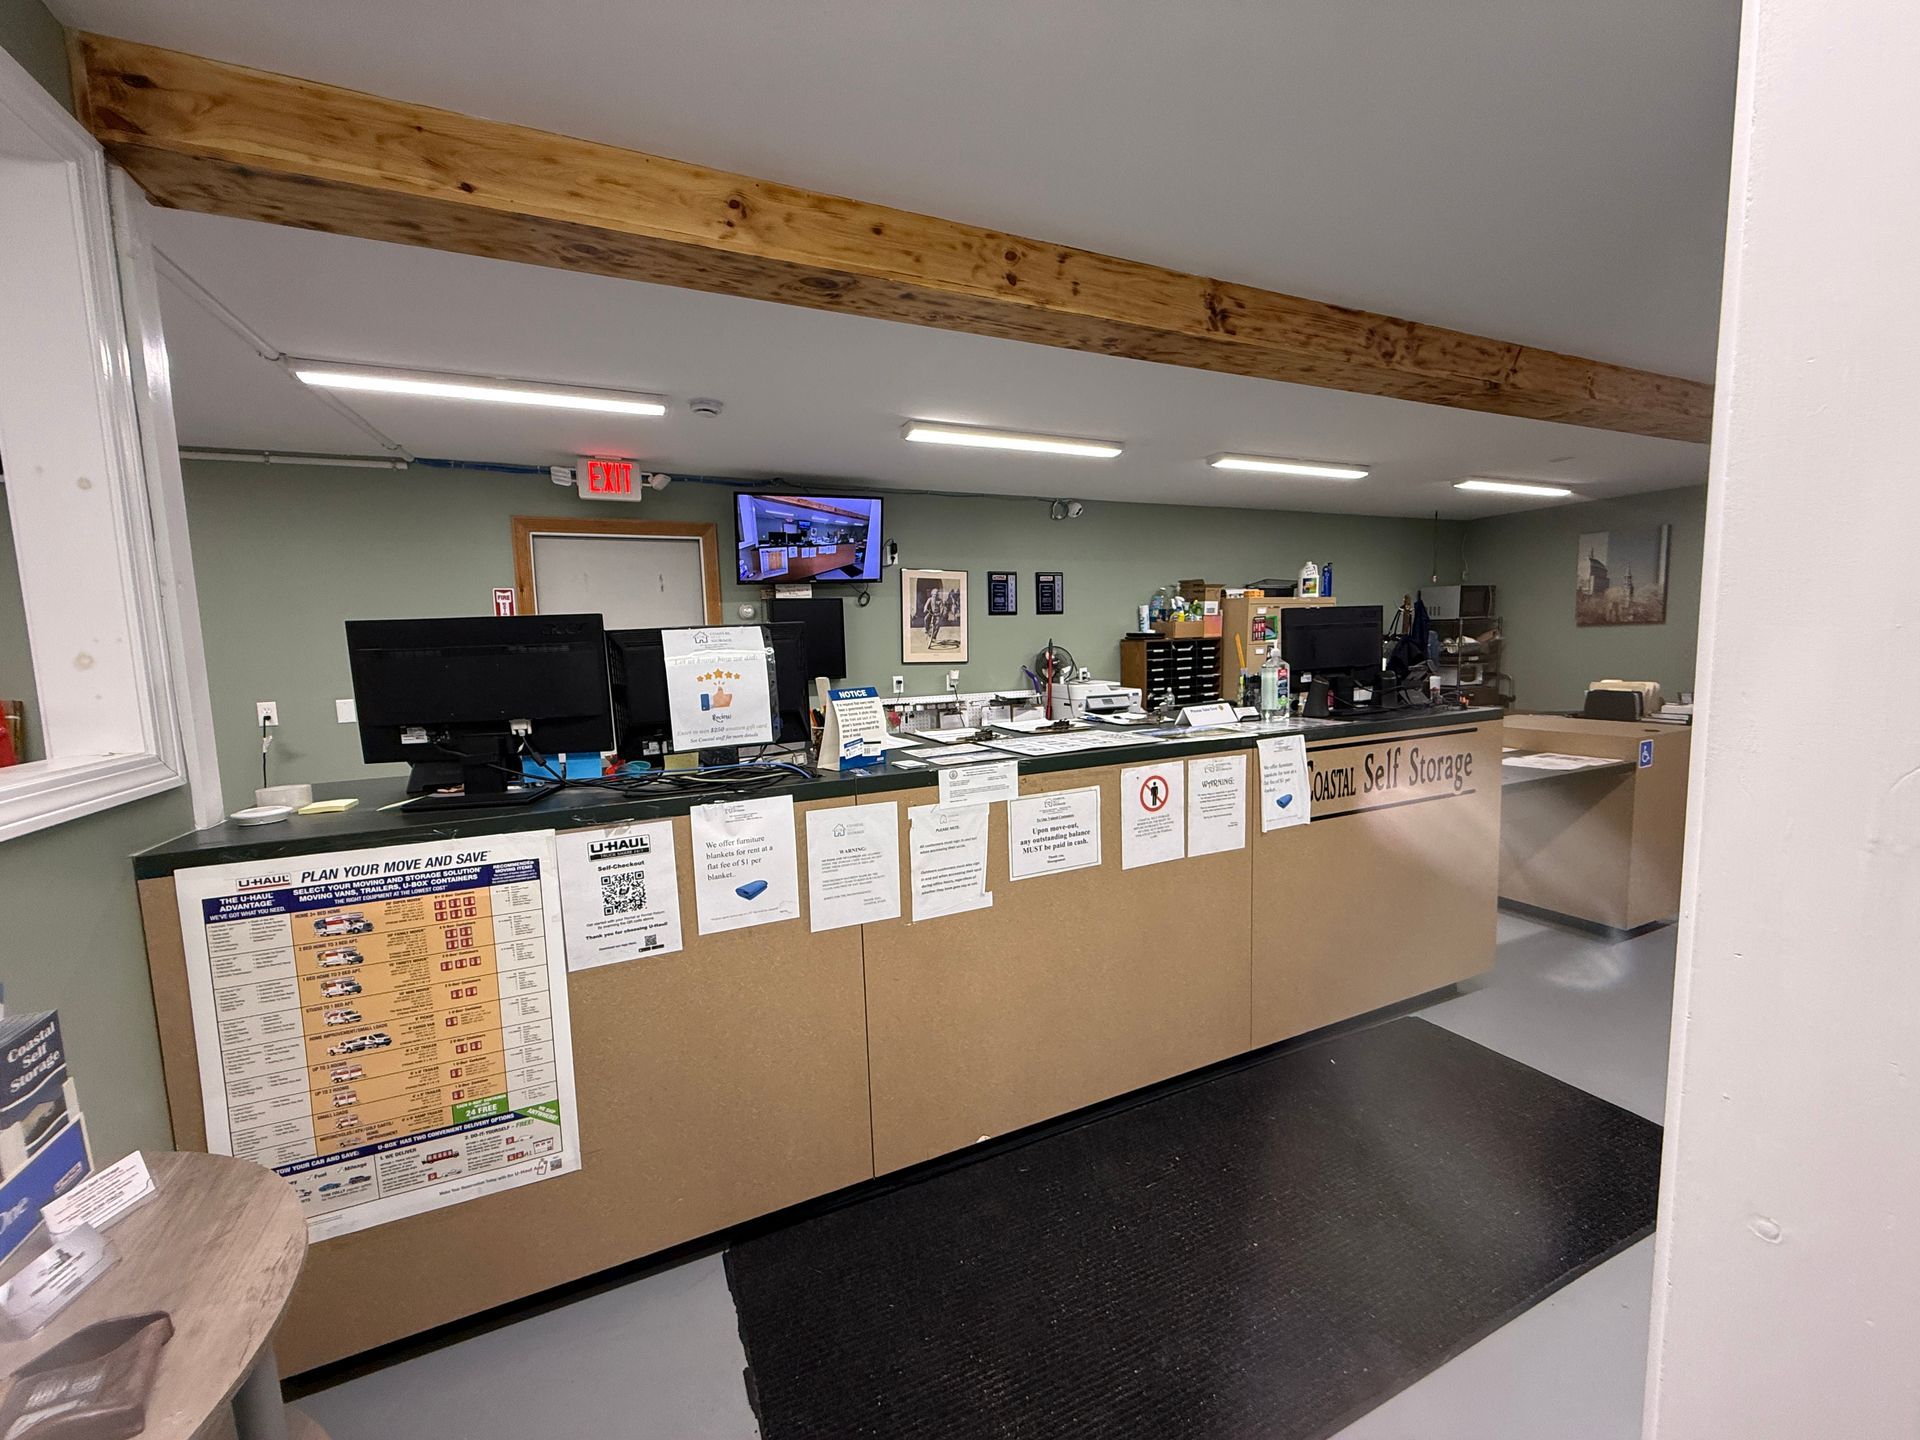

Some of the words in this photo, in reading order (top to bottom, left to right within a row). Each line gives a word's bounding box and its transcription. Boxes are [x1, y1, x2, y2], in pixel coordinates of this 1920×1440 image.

[587, 460, 632, 494] EXIT
[838, 690, 868, 698] NOTICE
[1363, 746, 1401, 793] Self
[1409, 746, 1473, 791] Storage
[1032, 826, 1049, 835] Upon
[1049, 822, 1079, 831] move-out,
[590, 837, 648, 853] U-HAUL
[705, 841, 717, 849] We
[718, 839, 735, 848] offer
[736, 835, 765, 845] furniture
[1019, 838, 1031, 846] any
[1032, 831, 1068, 844] outstanding
[1068, 829, 1091, 838] balance
[706, 851, 735, 860] blankets
[736, 848, 745, 856] for
[1022, 845, 1043, 854] MUST
[1052, 841, 1065, 851] paid
[1073, 838, 1088, 846] cash.
[301, 868, 339, 883] PLAN
[343, 863, 380, 879] YOUR
[383, 858, 423, 873] MOVE
[424, 854, 453, 869] AND
[455, 850, 488, 864] SAVE
[597, 860, 645, 872] Self-Checkout
[707, 863, 718, 871] flat
[720, 861, 730, 869] fee
[731, 859, 740, 867] of
[740, 858, 749, 866] $1
[750, 857, 761, 867] per
[238, 874, 289, 887] U-HAUL
[292, 885, 325, 896] SELECT
[327, 882, 352, 892] YOUR
[352, 878, 385, 888] MOVING
[386, 874, 403, 883] AND
[405, 870, 442, 882] STORAGE
[442, 867, 479, 877] SOLUTION
[298, 893, 332, 903] MOVING
[334, 889, 359, 900] VANS,
[360, 883, 401, 895] TRAILERS,
[402, 879, 428, 889] U-BOX
[430, 874, 478, 886] CONTAINERS
[219, 897, 238, 905] THE
[239, 893, 273, 903] U-HAUL
[362, 892, 392, 901] EQUIPMENT
[411, 886, 432, 895] LOWEST
[209, 913, 227, 921] WE'VE
[239, 909, 257, 917] WHAT
[269, 905, 286, 914] NEED.
[219, 900, 273, 913] ADVANTAGE
[6, 1021, 55, 1063] Coastal
[22, 1041, 47, 1069] Self
[10, 1050, 60, 1093] Storage
[465, 1107, 476, 1117] 24
[477, 1103, 498, 1113] FREE
[399, 1137, 413, 1145] HAS
[413, 1134, 427, 1142] TWO
[427, 1126, 463, 1139] CONVENIENT
[463, 1119, 490, 1131] DELIVERY
[490, 1113, 515, 1123] OPTIONS
[291, 1162, 310, 1171] YOUR
[310, 1158, 325, 1167] CAR
[325, 1155, 340, 1163] AND
